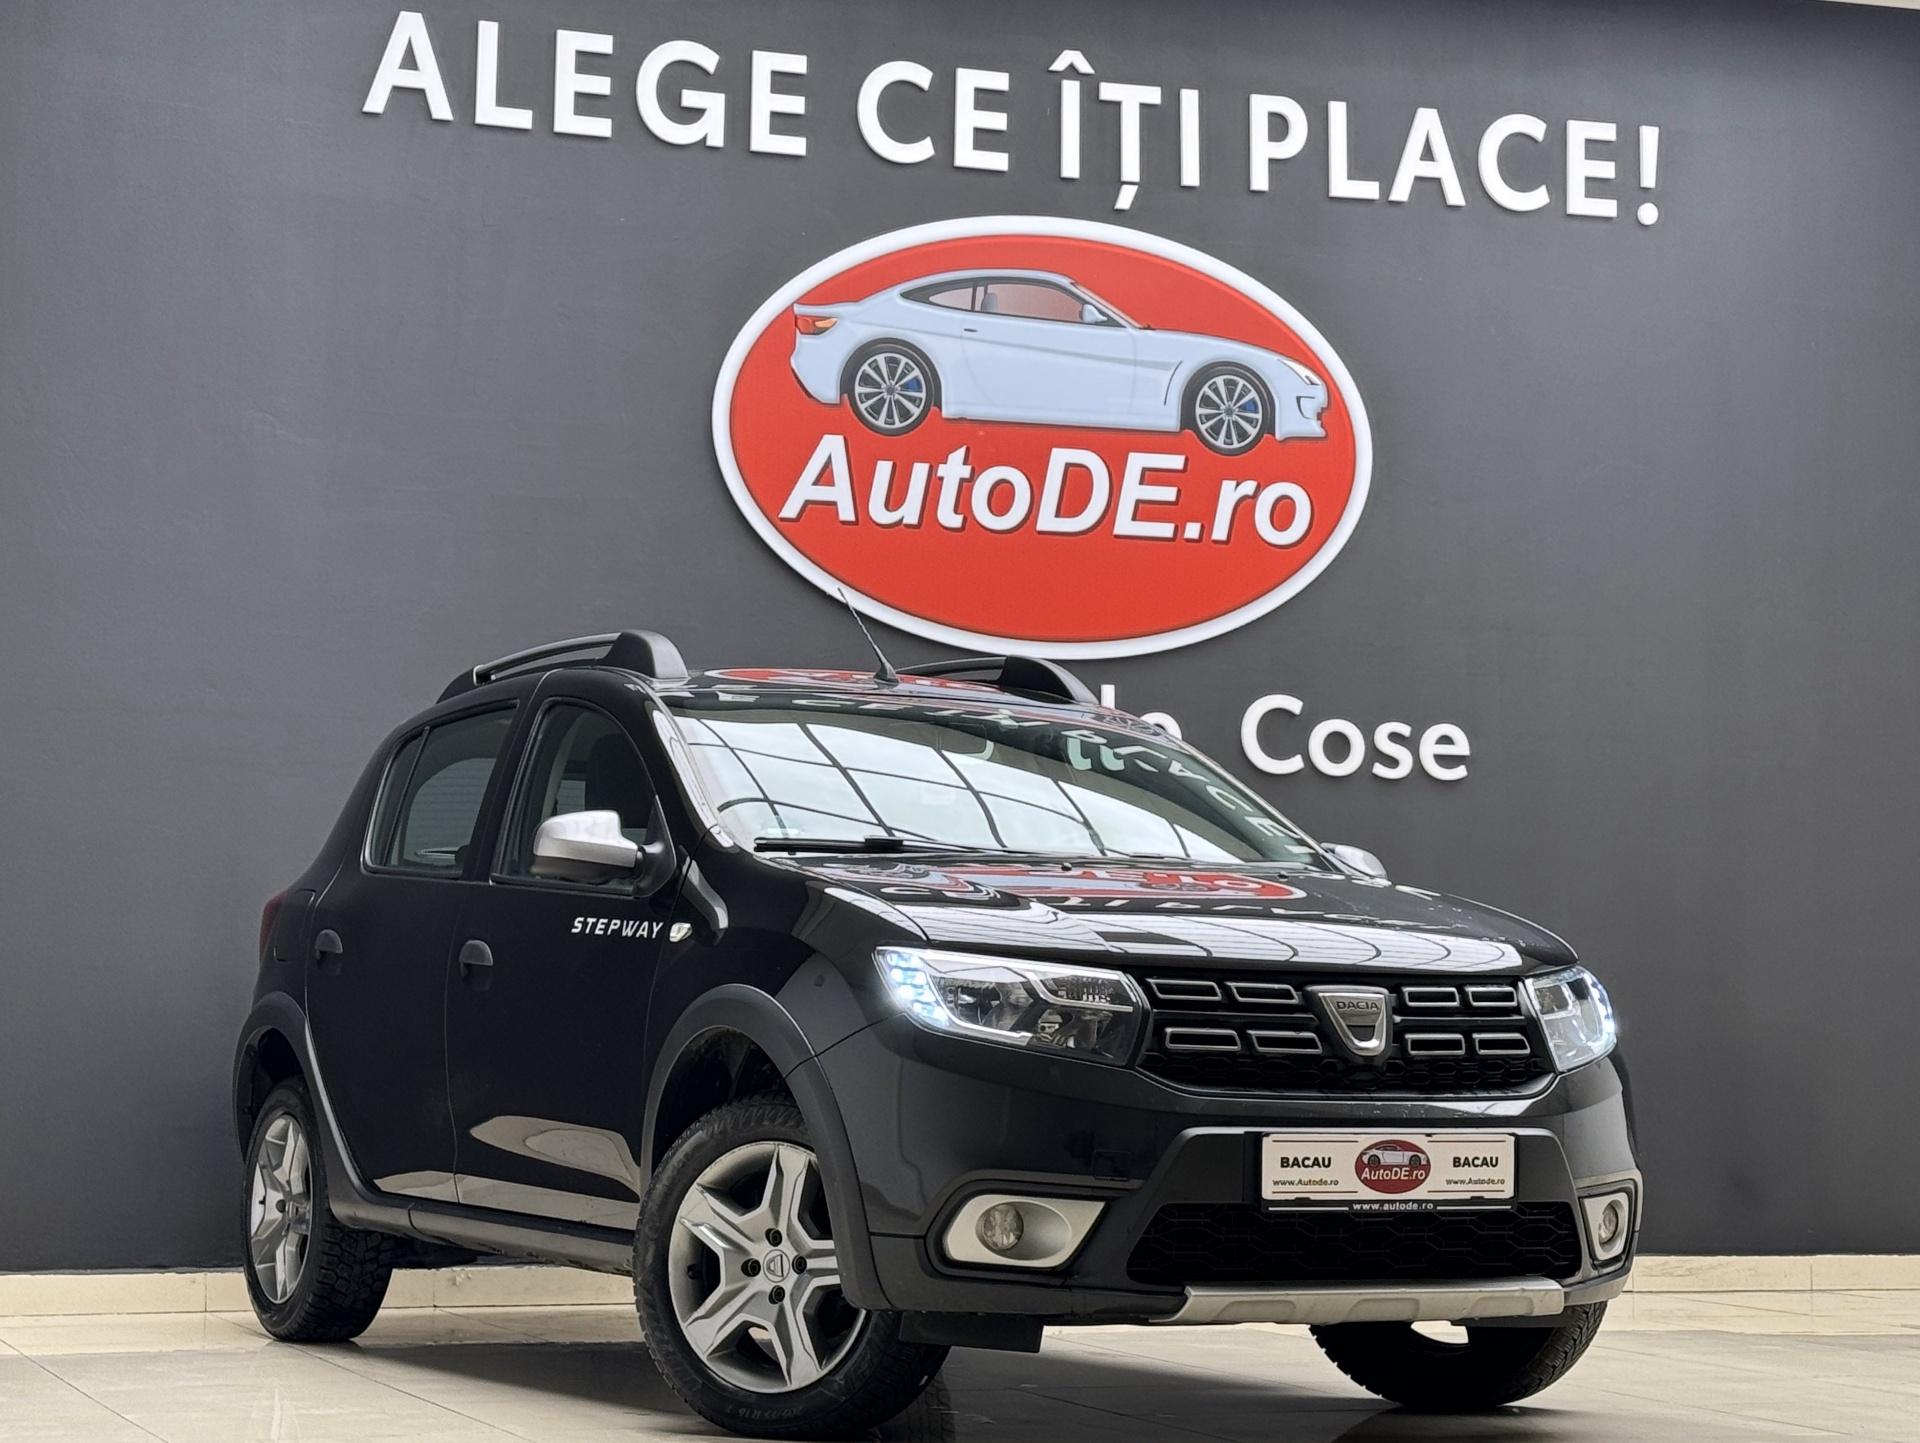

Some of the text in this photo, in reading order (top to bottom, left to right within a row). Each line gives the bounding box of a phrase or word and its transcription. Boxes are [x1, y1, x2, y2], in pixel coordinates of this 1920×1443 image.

[363, 10, 810, 158] ALEGE
[857, 60, 1011, 173] CE
[1249, 93, 1661, 227] PLACE!
[779, 434, 1313, 547] AutoDE.ro
[1240, 693, 1471, 781] Cose
[571, 917, 664, 939] STEPWAY
[1336, 1001, 1380, 1011] DACIA
[1280, 1157, 1332, 1169] BACAU
[1452, 1156, 1499, 1168] BACAU
[1361, 1167, 1426, 1181] AutoDE.ro
[1272, 1178, 1340, 1187] www.Autode.ro
[1352, 1201, 1434, 1211] www.autode.ro
